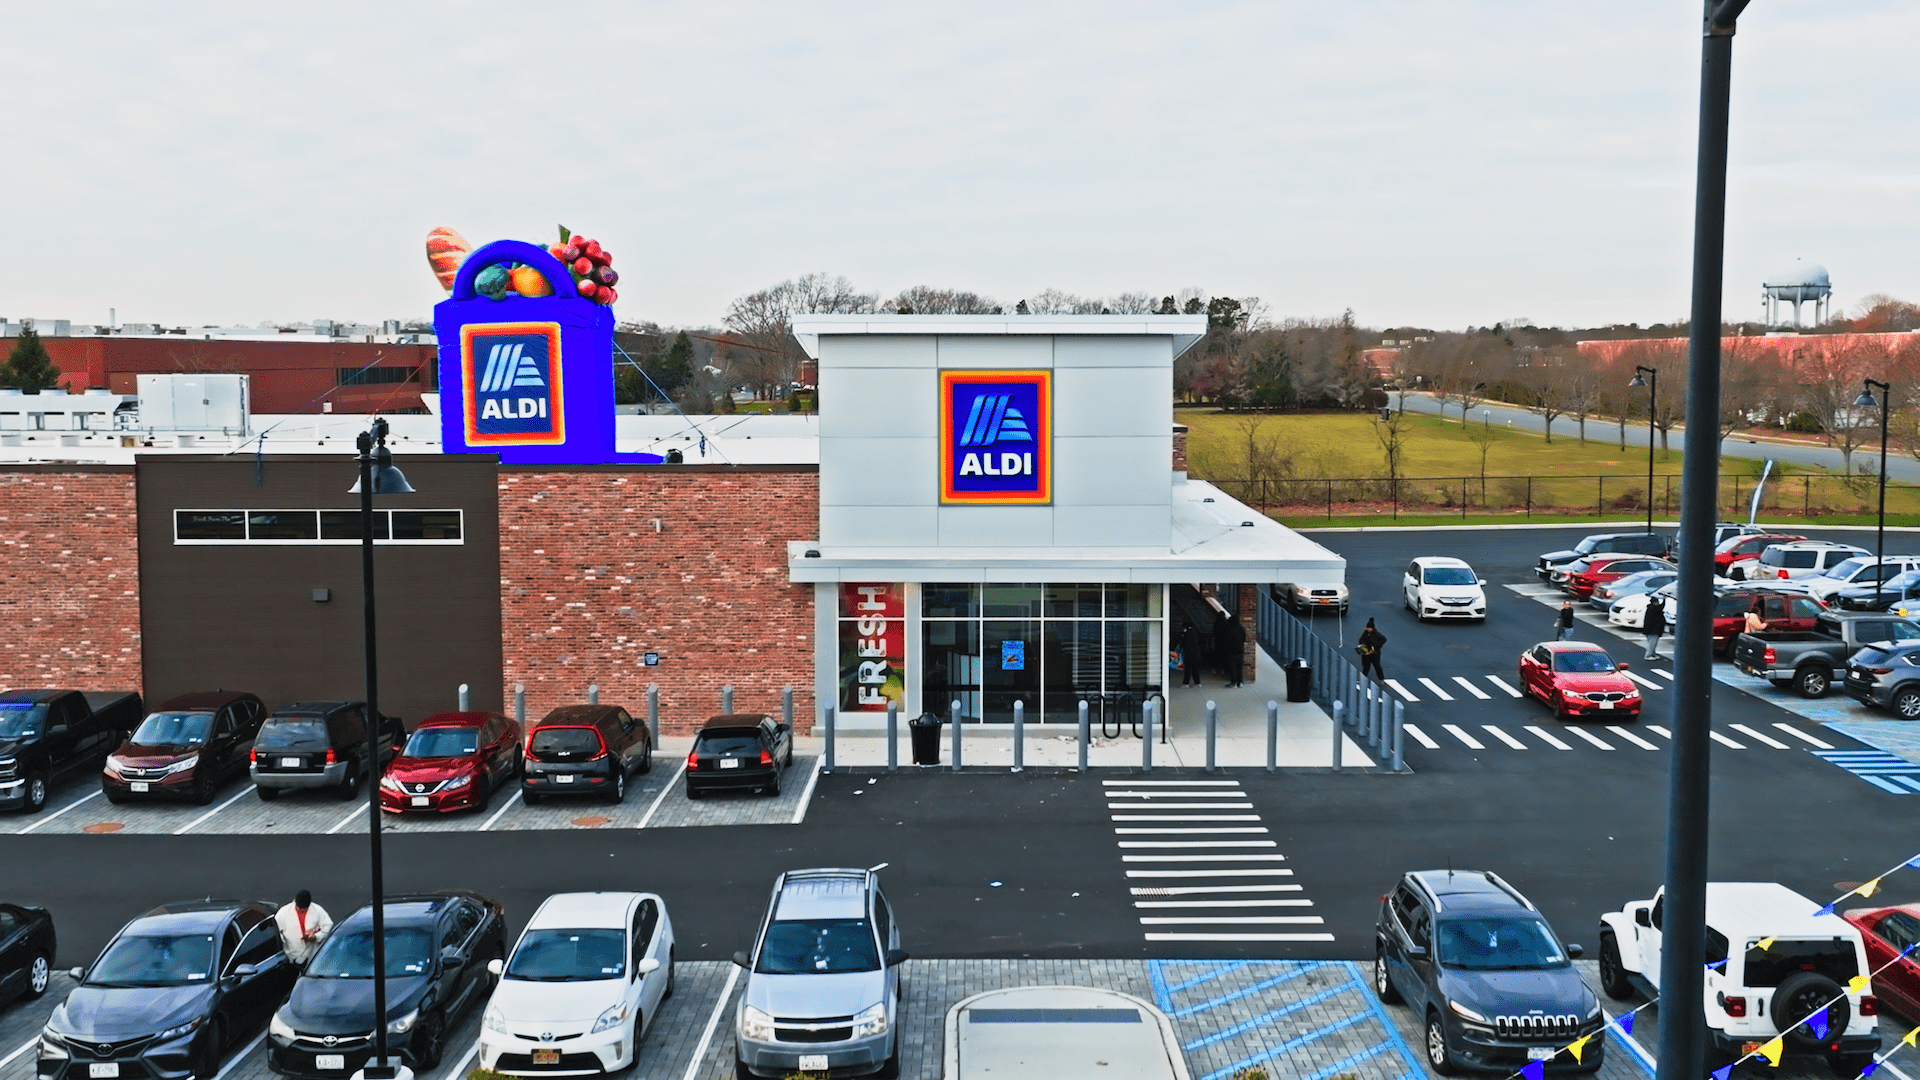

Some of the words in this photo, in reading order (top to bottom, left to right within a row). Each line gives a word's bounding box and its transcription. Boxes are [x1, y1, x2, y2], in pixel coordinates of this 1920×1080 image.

[481, 398, 547, 420] ALDI
[959, 452, 1032, 476] ALDI
[857, 586, 887, 705] FRESH
